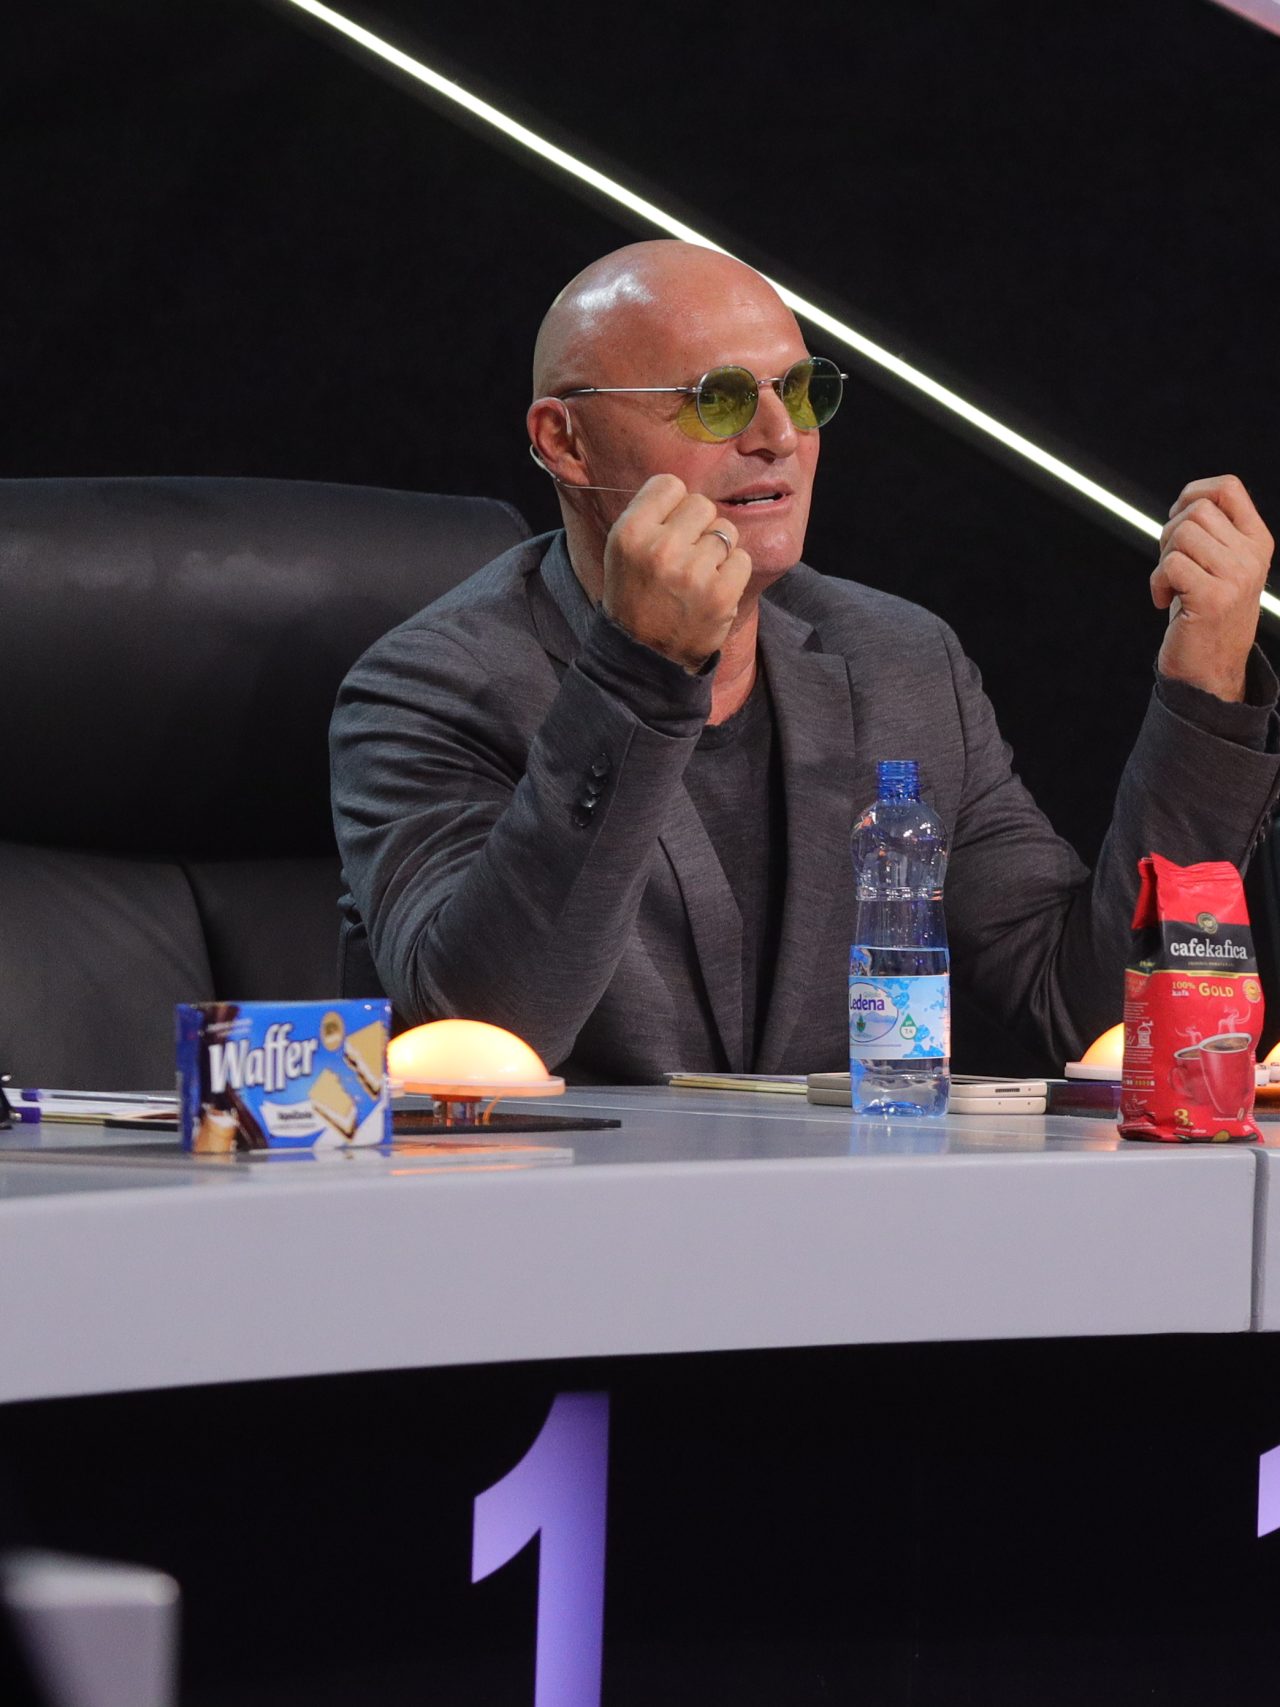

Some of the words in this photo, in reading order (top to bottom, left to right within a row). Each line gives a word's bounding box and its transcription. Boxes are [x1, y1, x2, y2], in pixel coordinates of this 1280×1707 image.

[1170, 938, 1248, 960] cafekafica
[1171, 981, 1196, 990] 100%
[208, 1022, 318, 1093] Waffer
